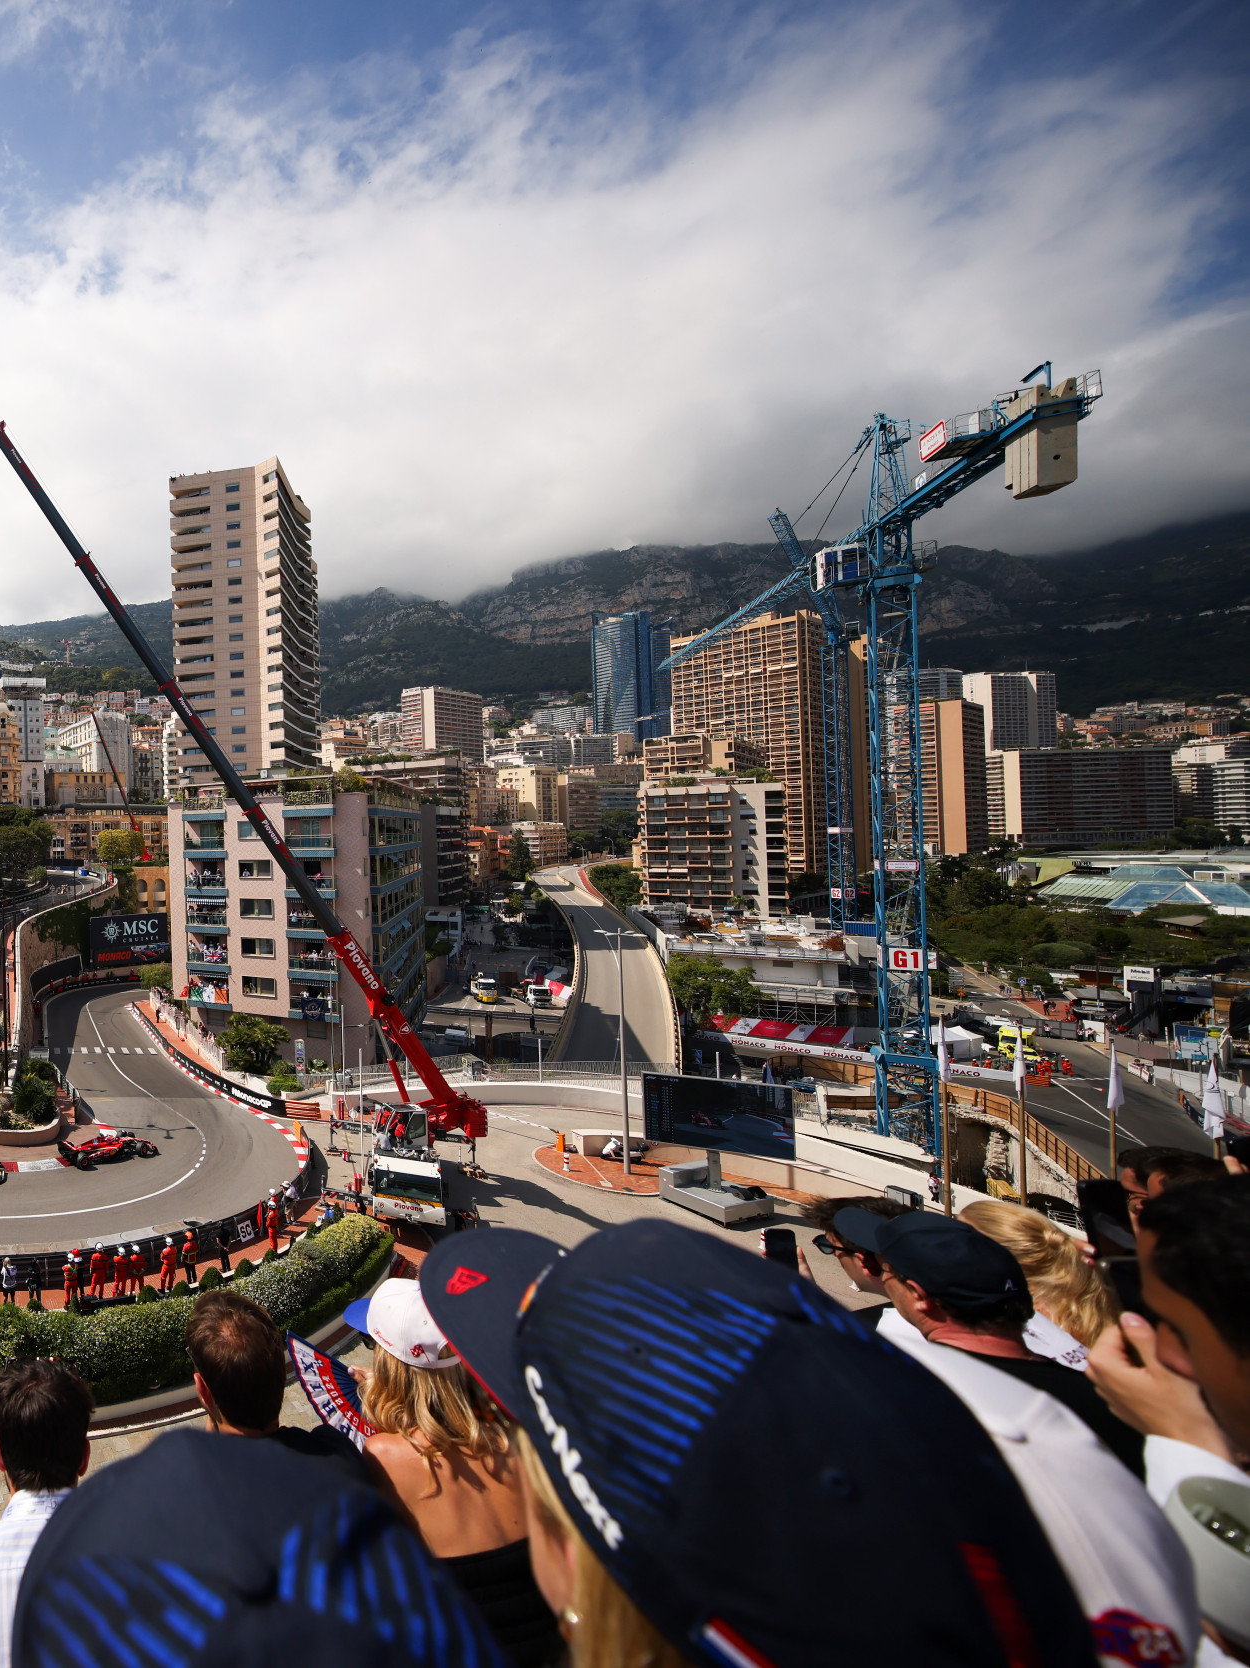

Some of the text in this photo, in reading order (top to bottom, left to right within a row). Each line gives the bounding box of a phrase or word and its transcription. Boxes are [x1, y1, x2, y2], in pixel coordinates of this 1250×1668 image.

[178, 697, 192, 716] Piovano
[262, 819, 280, 844] Piovano
[832, 889, 840, 897] G2
[845, 889, 854, 897] G2
[123, 919, 158, 935] MSC
[98, 951, 131, 962] MONACO
[894, 950, 918, 968] G1
[344, 941, 379, 990] Piovano
[731, 1039, 766, 1048] MONACO
[774, 1045, 811, 1054] MONACO
[823, 1051, 862, 1060] MONACO
[952, 1068, 980, 1077] NACO
[231, 1087, 272, 1108] #MonacoGP
[394, 1203, 424, 1213] Piovano
[240, 1224, 251, 1236] SC
[322, 1375, 343, 1405] 2024
